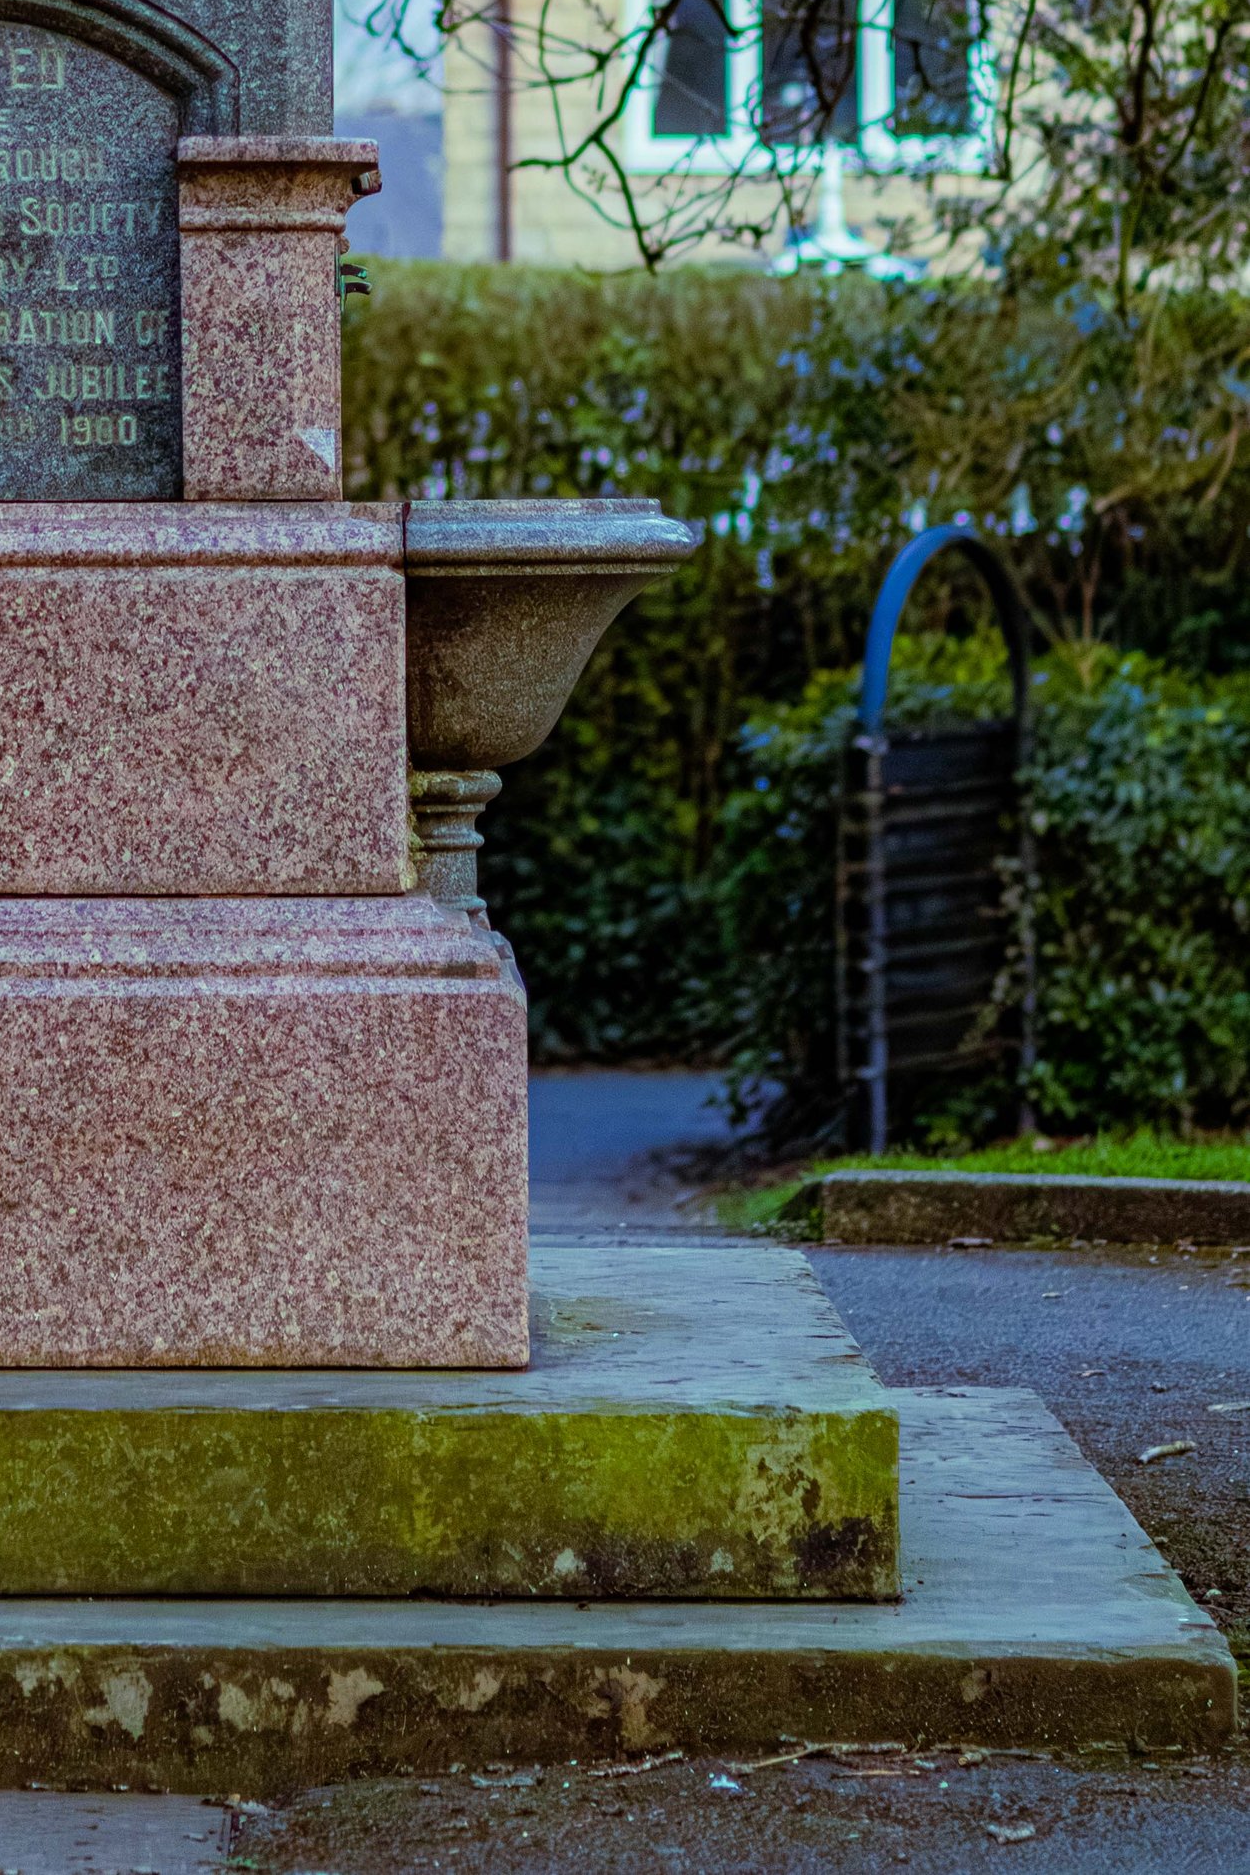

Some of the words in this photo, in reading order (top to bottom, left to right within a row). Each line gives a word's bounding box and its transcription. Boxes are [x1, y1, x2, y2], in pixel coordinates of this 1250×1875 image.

[21, 197, 163, 237] SOCIETY
[136, 309, 171, 345] OF
[36, 364, 171, 401] JUBILEE
[60, 415, 138, 447] 1900
